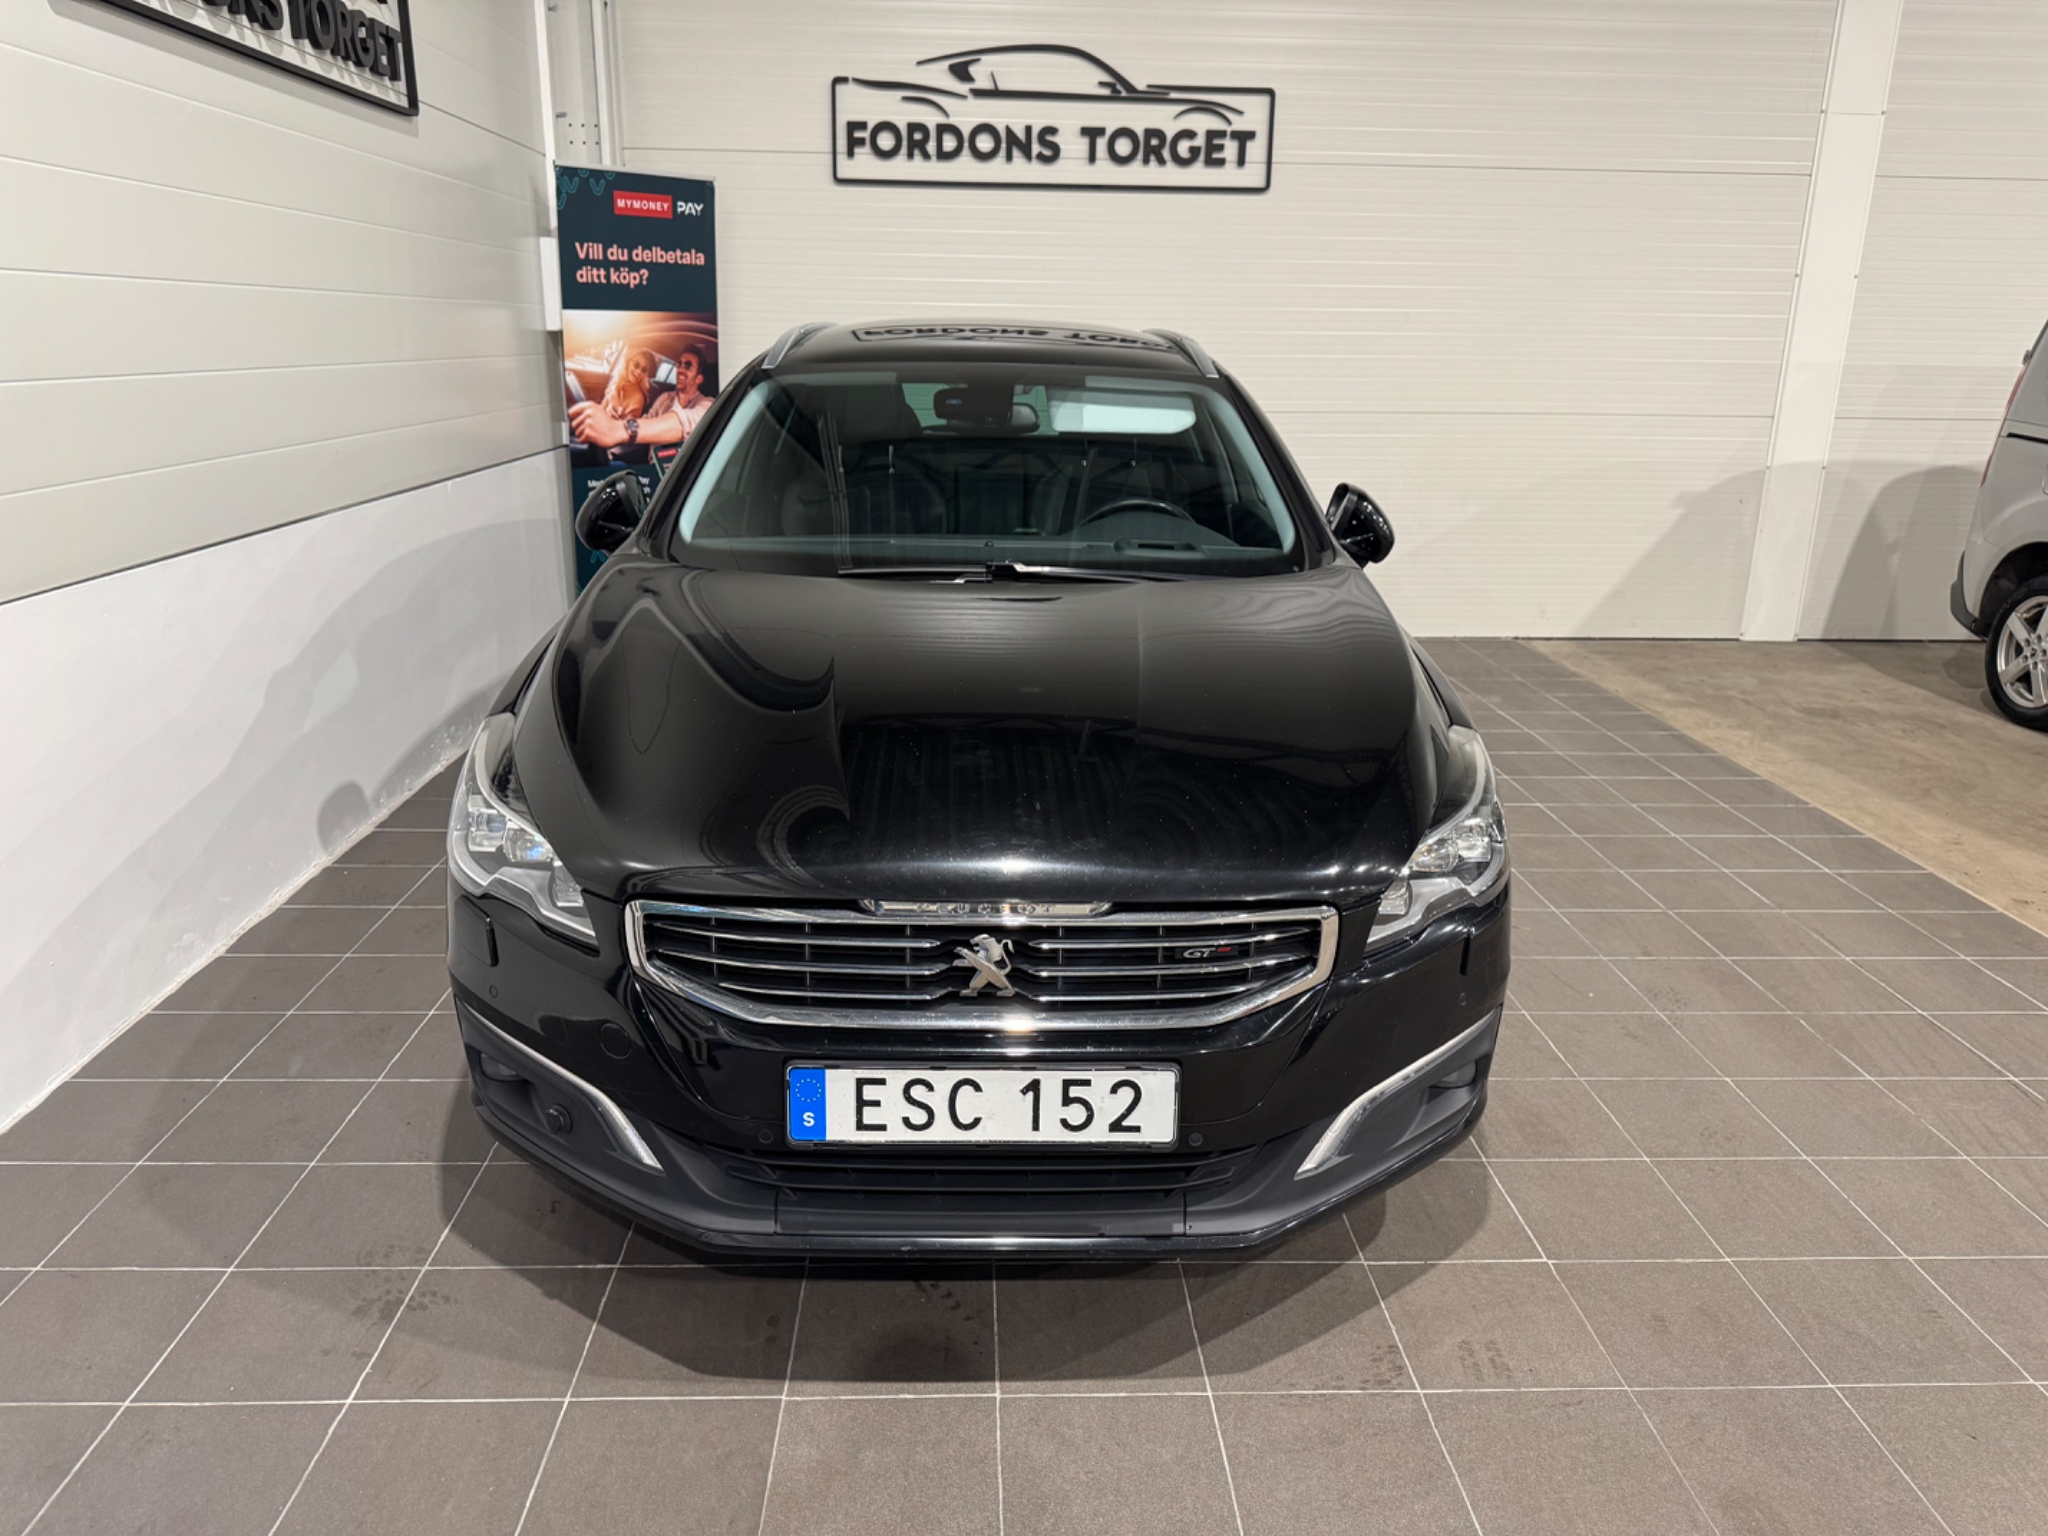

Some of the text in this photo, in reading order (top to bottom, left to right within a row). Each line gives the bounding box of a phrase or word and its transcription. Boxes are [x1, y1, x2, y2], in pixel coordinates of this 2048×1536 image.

[846, 120, 1256, 168] FORDONS TORGET
[617, 198, 704, 216] MYMONEY PAY
[575, 242, 705, 265] Vill du delbetala
[576, 266, 649, 288] ditt köp?
[1183, 947, 1216, 959] GT
[855, 1078, 1142, 1133] ESC 152
[803, 1112, 815, 1127] S
